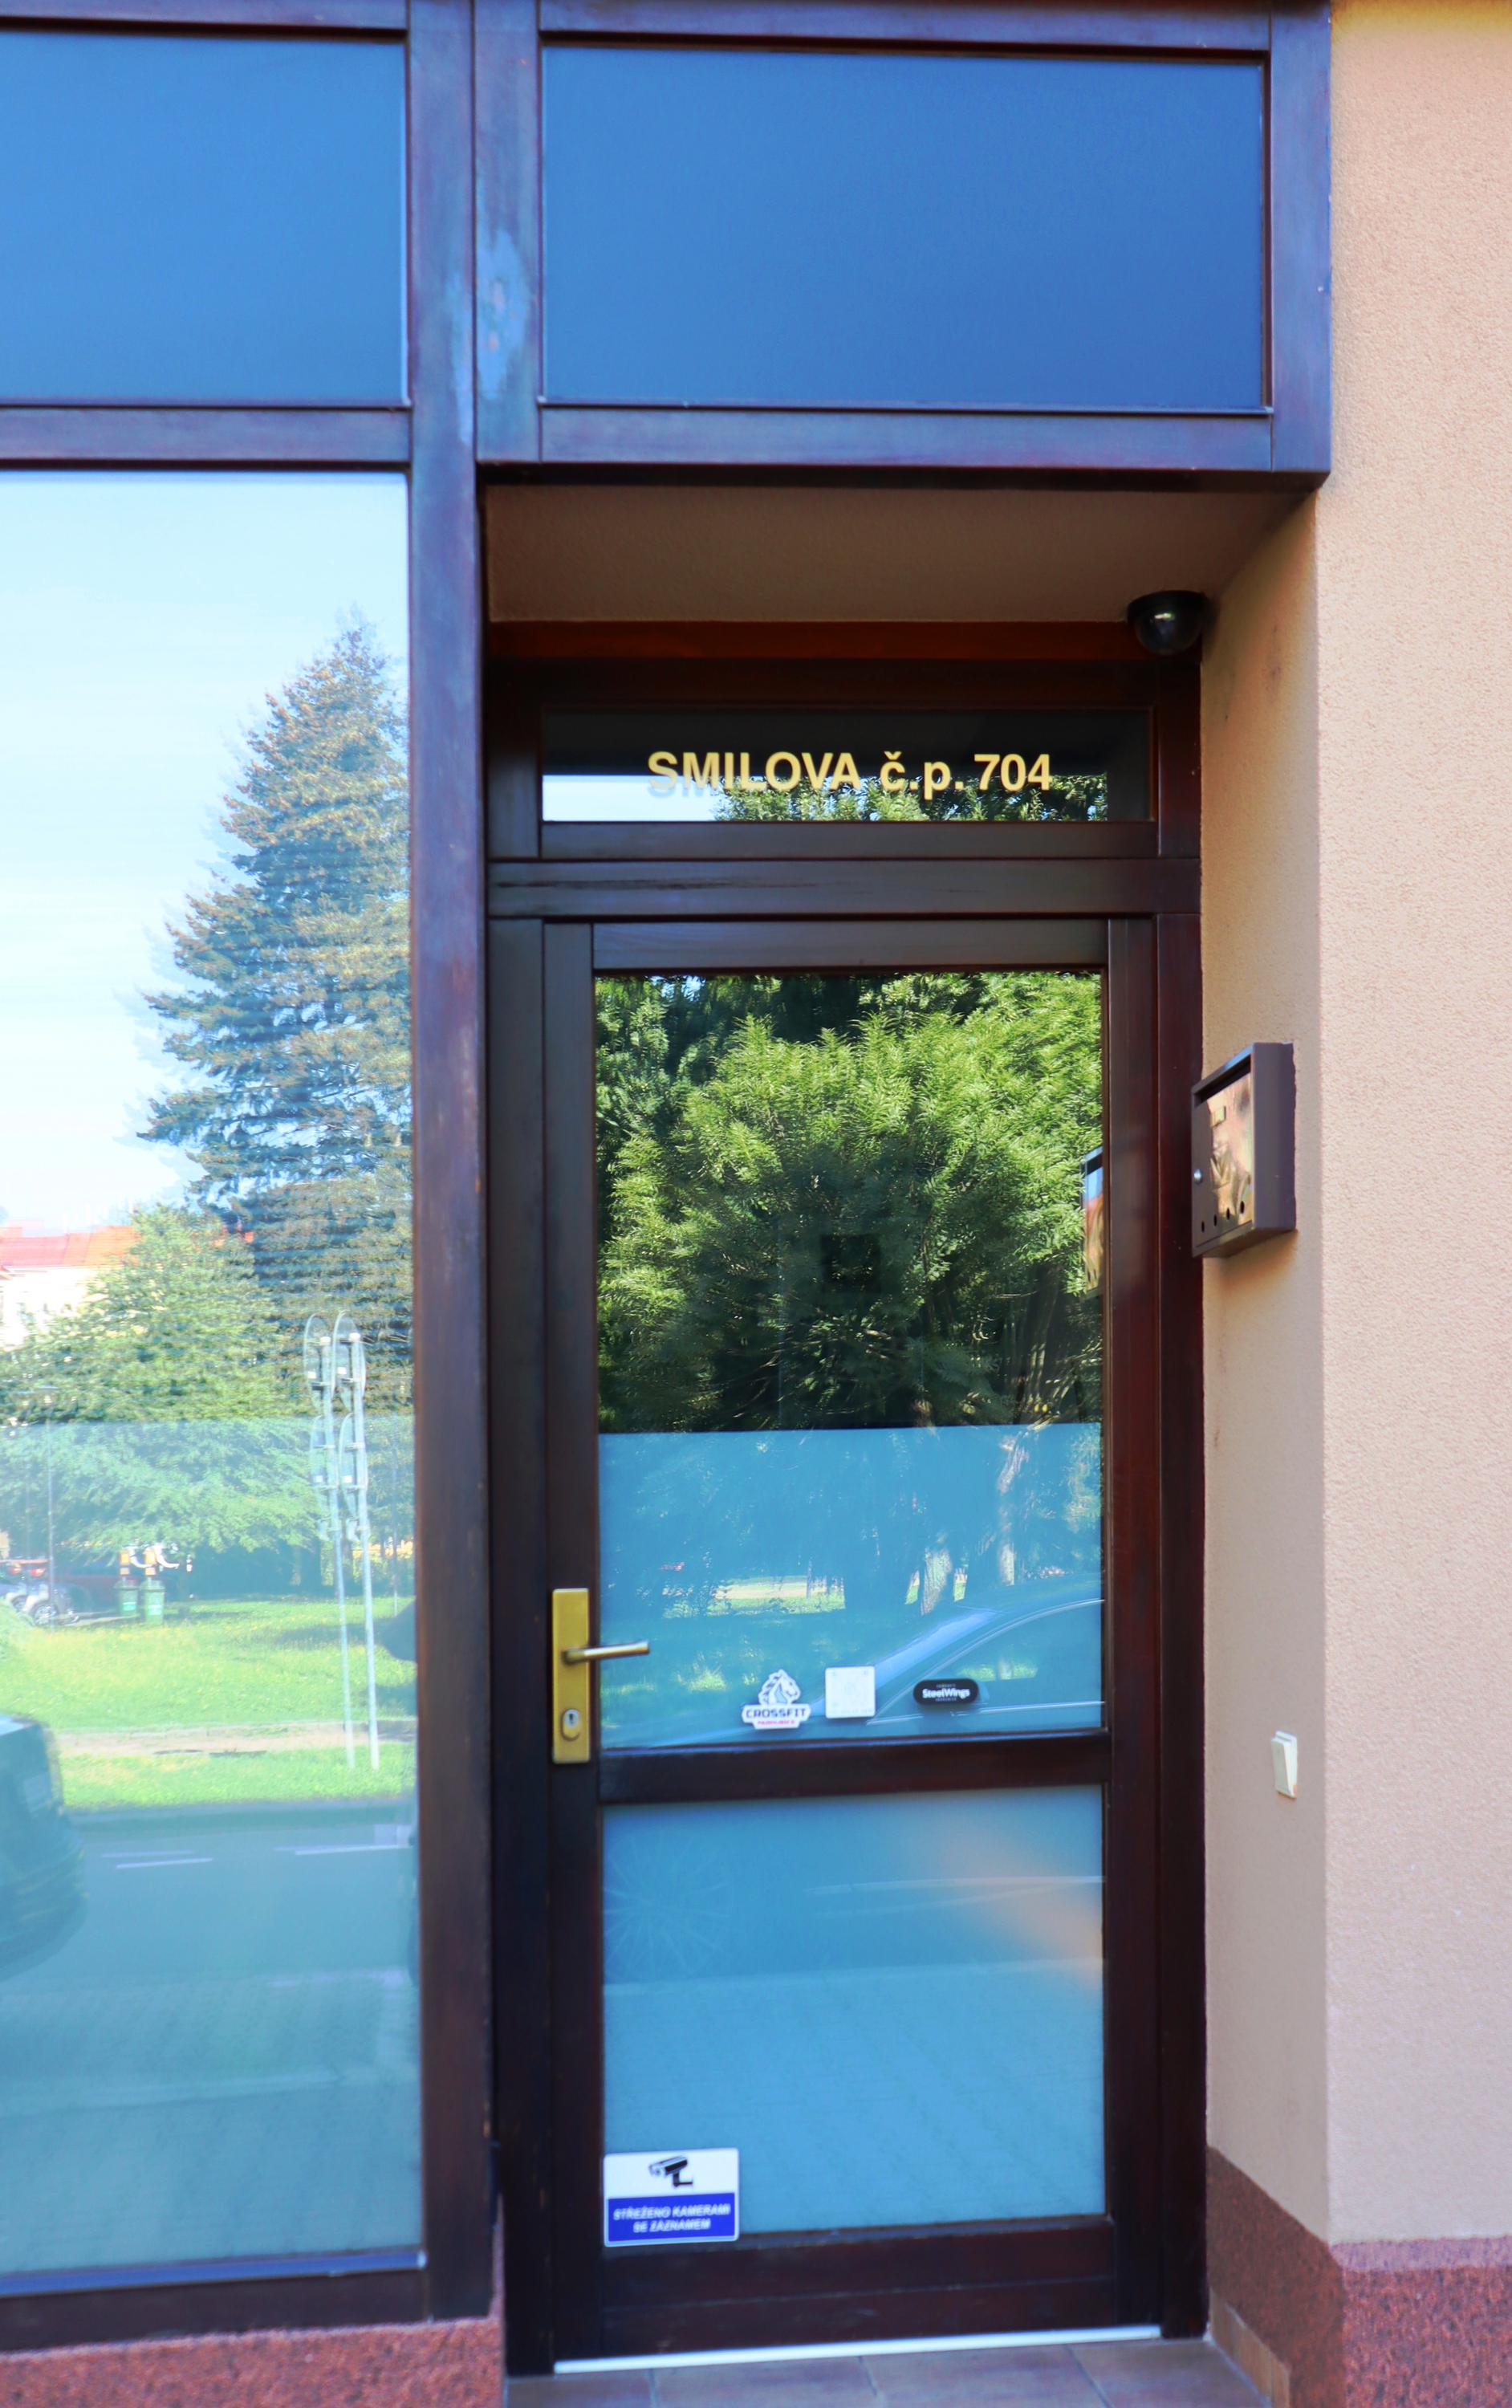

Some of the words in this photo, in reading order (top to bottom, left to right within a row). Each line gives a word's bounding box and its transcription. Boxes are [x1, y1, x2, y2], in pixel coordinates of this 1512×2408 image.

[648, 751, 860, 791] SMILOVA
[880, 751, 964, 799] č.p.
[973, 753, 1053, 791] 704
[922, 1688, 970, 1699] SteelWings
[746, 1707, 807, 1719] CROSSFIT
[672, 2203, 731, 2218] KAMERAMI
[632, 2220, 648, 2233] SE
